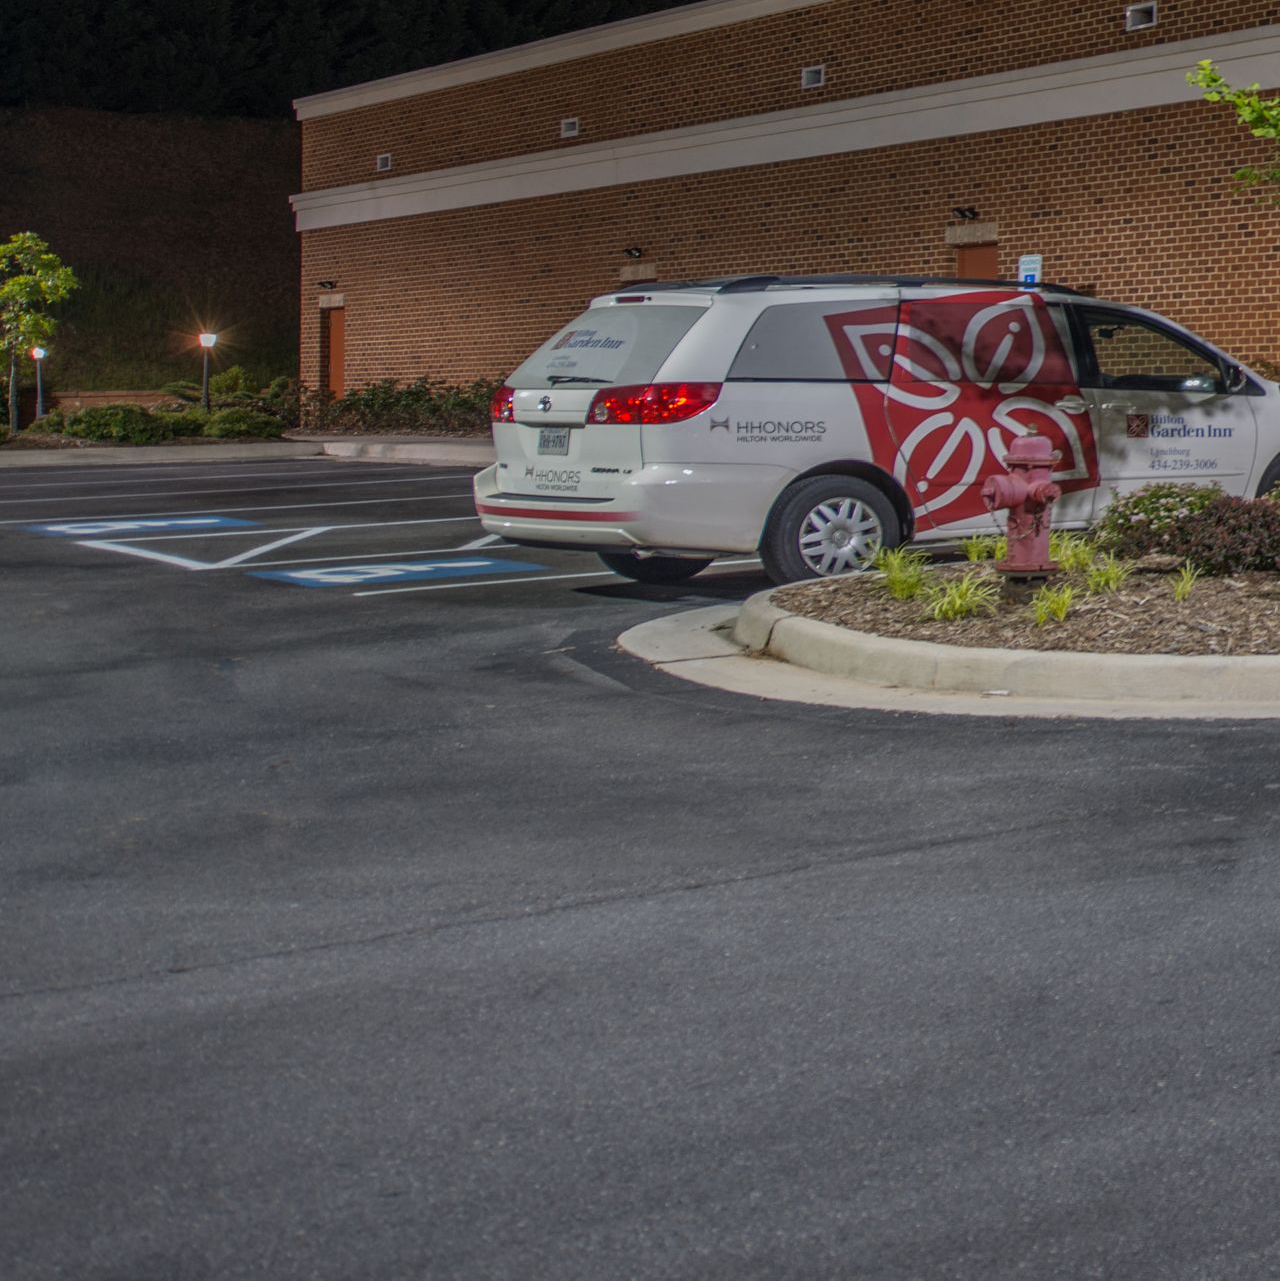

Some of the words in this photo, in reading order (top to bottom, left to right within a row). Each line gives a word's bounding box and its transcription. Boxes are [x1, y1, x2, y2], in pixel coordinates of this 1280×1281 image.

[600, 337, 624, 349] Inn
[1150, 414, 1185, 424] Hilton
[736, 420, 827, 434] HHONORS
[1150, 425, 1204, 438] Garden
[1207, 425, 1232, 438] Inn
[736, 435, 767, 443] HILTON
[1149, 459, 1218, 471] 434-239-3006
[535, 469, 581, 484] HHONORS
